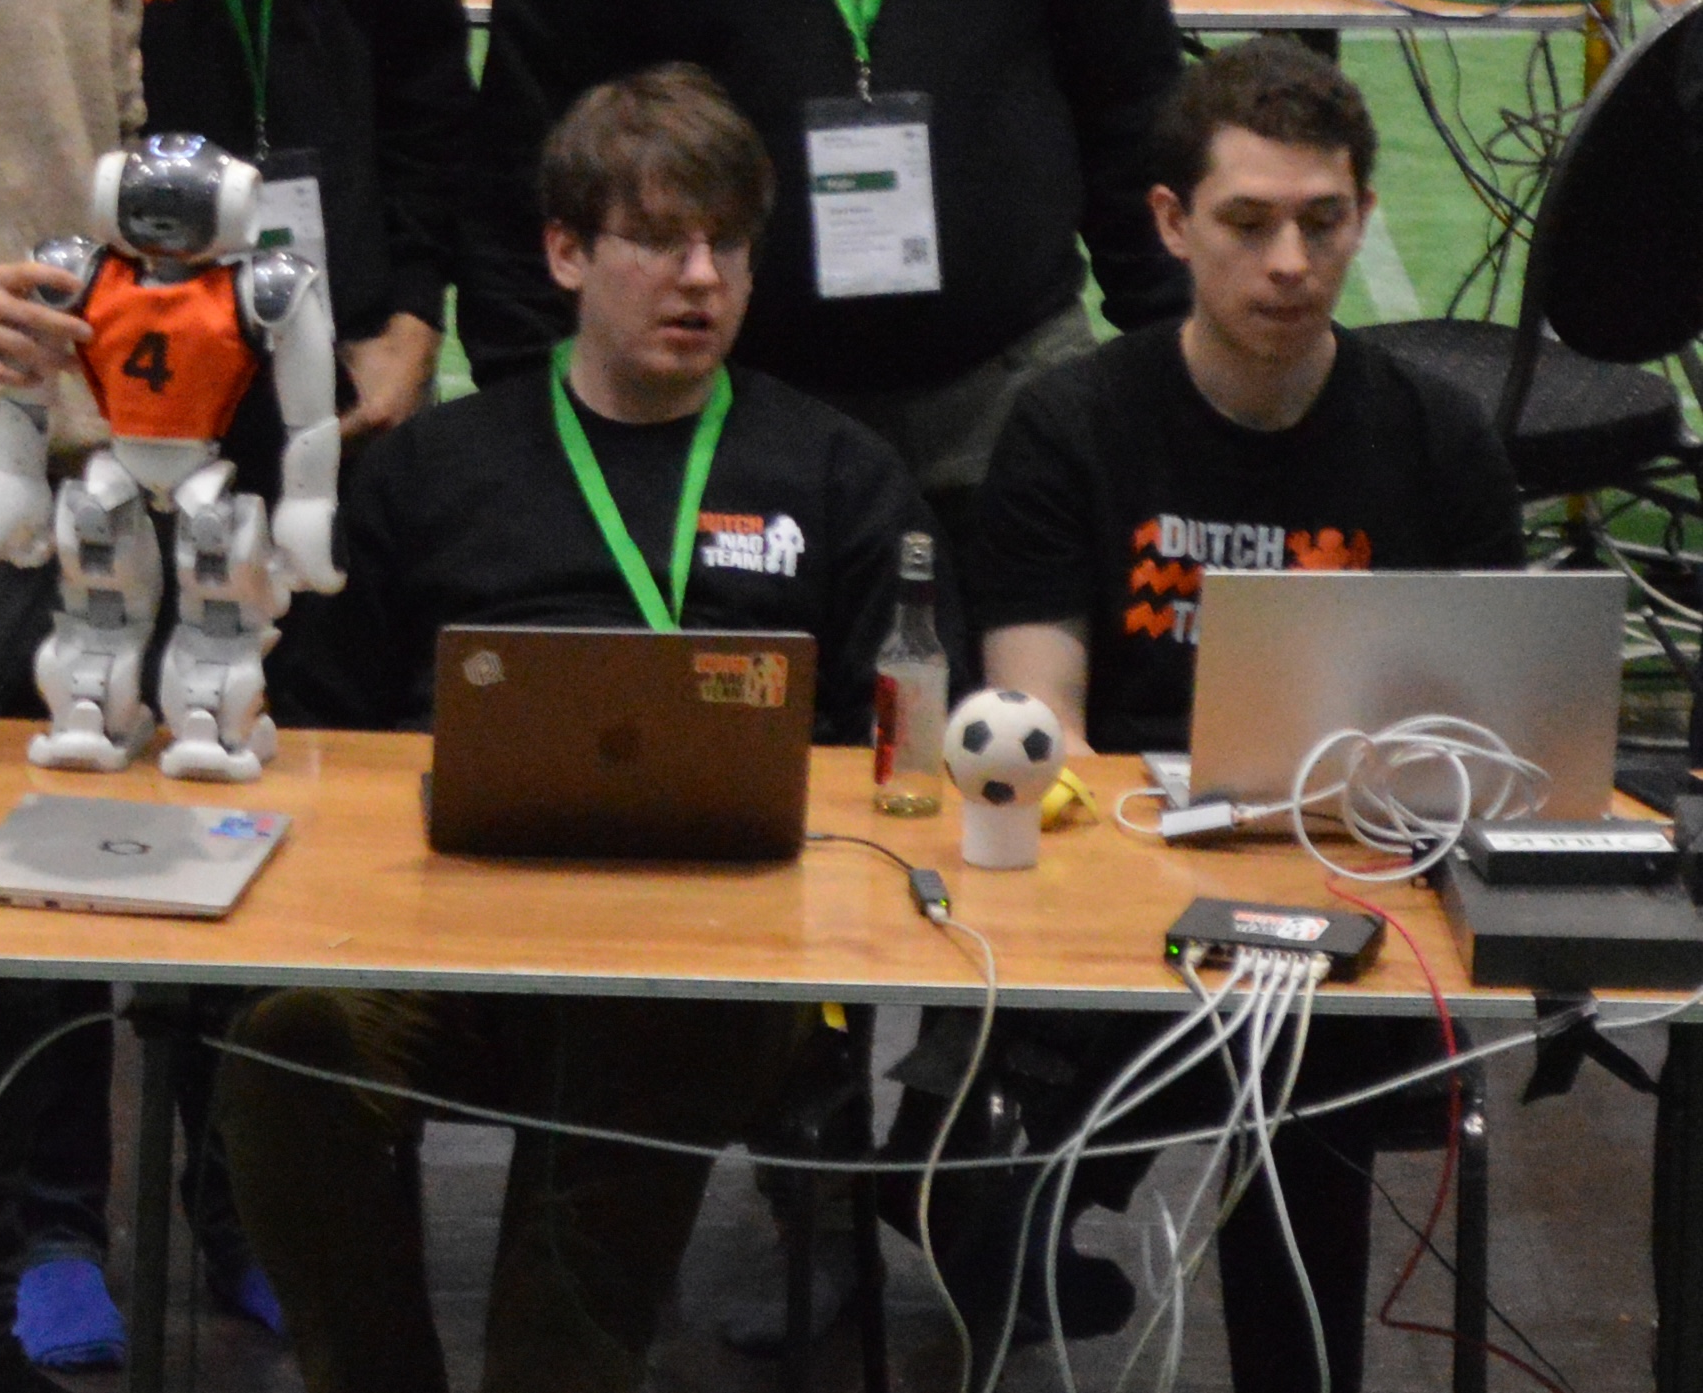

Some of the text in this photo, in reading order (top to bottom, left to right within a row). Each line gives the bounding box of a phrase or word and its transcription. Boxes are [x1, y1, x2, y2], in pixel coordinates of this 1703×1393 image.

[121, 331, 174, 393] 4
[701, 545, 765, 573] TEAM
[715, 531, 765, 555] NAO
[1158, 512, 1286, 570] DUTCH
